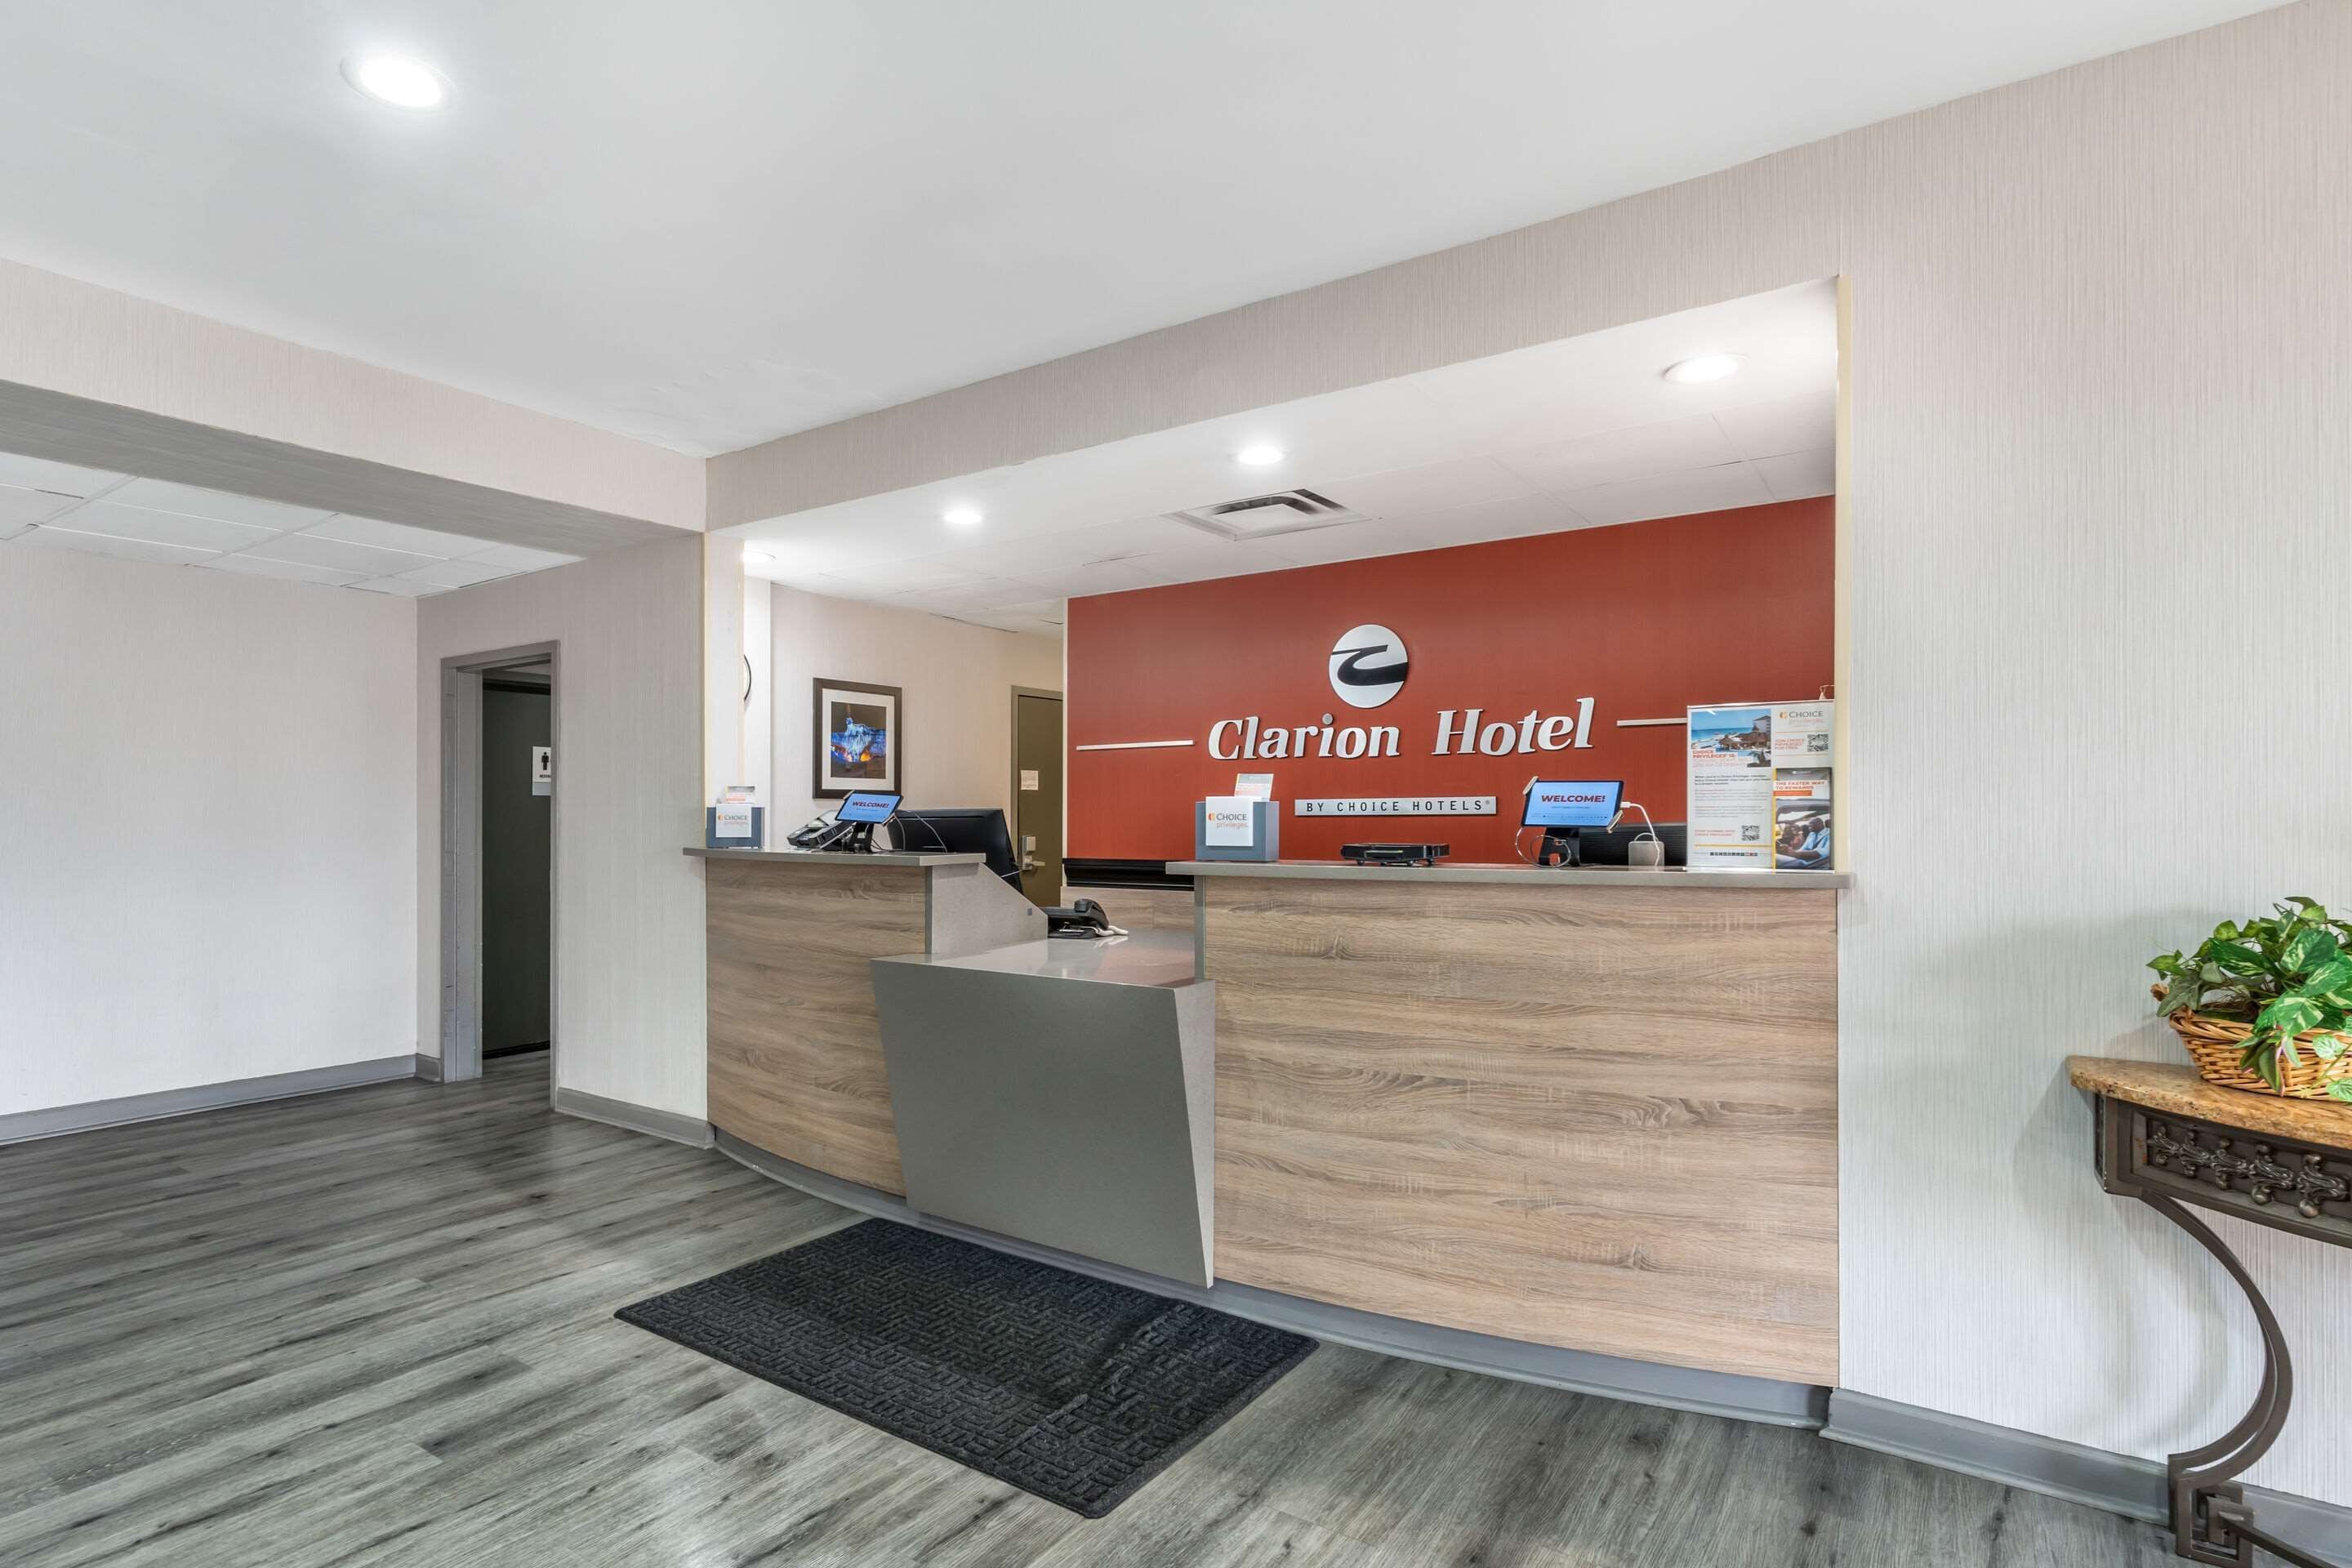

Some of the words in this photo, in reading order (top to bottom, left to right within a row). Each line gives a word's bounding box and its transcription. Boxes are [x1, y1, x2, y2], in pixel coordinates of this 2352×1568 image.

[1788, 710, 1824, 719] CHOICE
[1208, 712, 1401, 760] Clarion
[1432, 697, 1596, 756] Hotel
[1541, 795, 1606, 803] WELCOME!
[1307, 803, 1325, 812] BY
[1337, 801, 1400, 812] CHOICE
[1216, 813, 1248, 821] CHOICE
